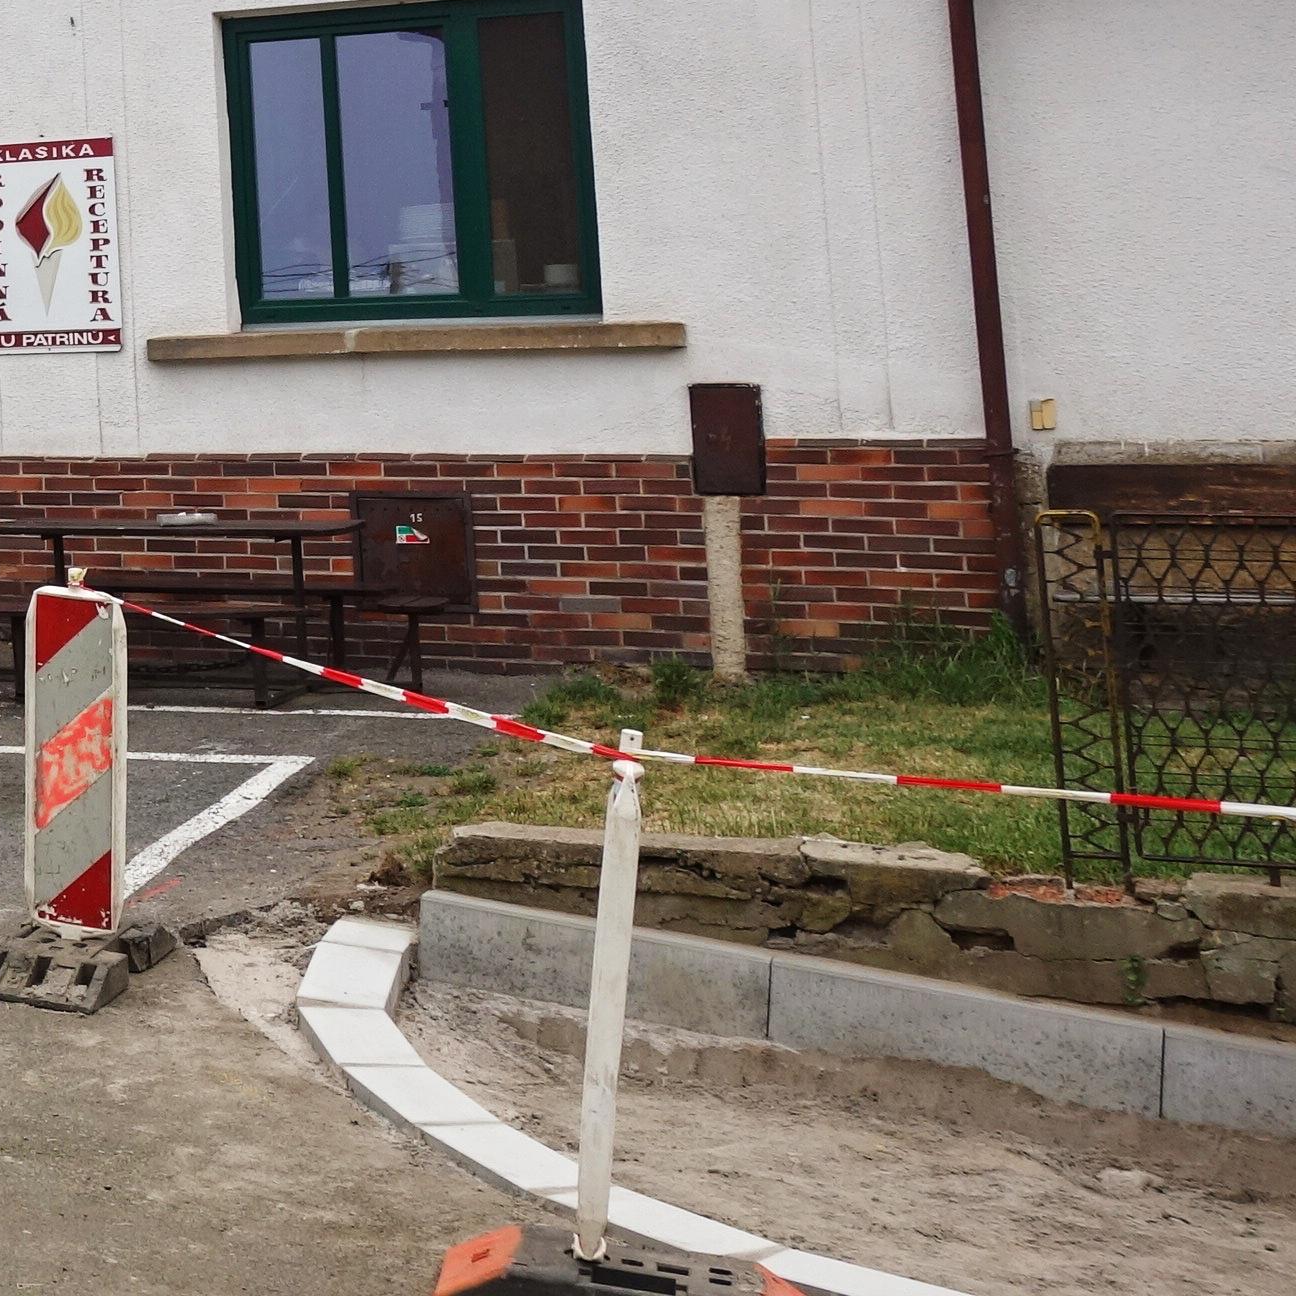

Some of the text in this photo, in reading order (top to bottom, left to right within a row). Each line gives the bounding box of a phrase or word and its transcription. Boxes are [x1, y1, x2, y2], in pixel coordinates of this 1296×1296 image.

[84, 168, 114, 322] RECEPTURA
[0, 334, 16, 347] U
[409, 513, 423, 523] 15
